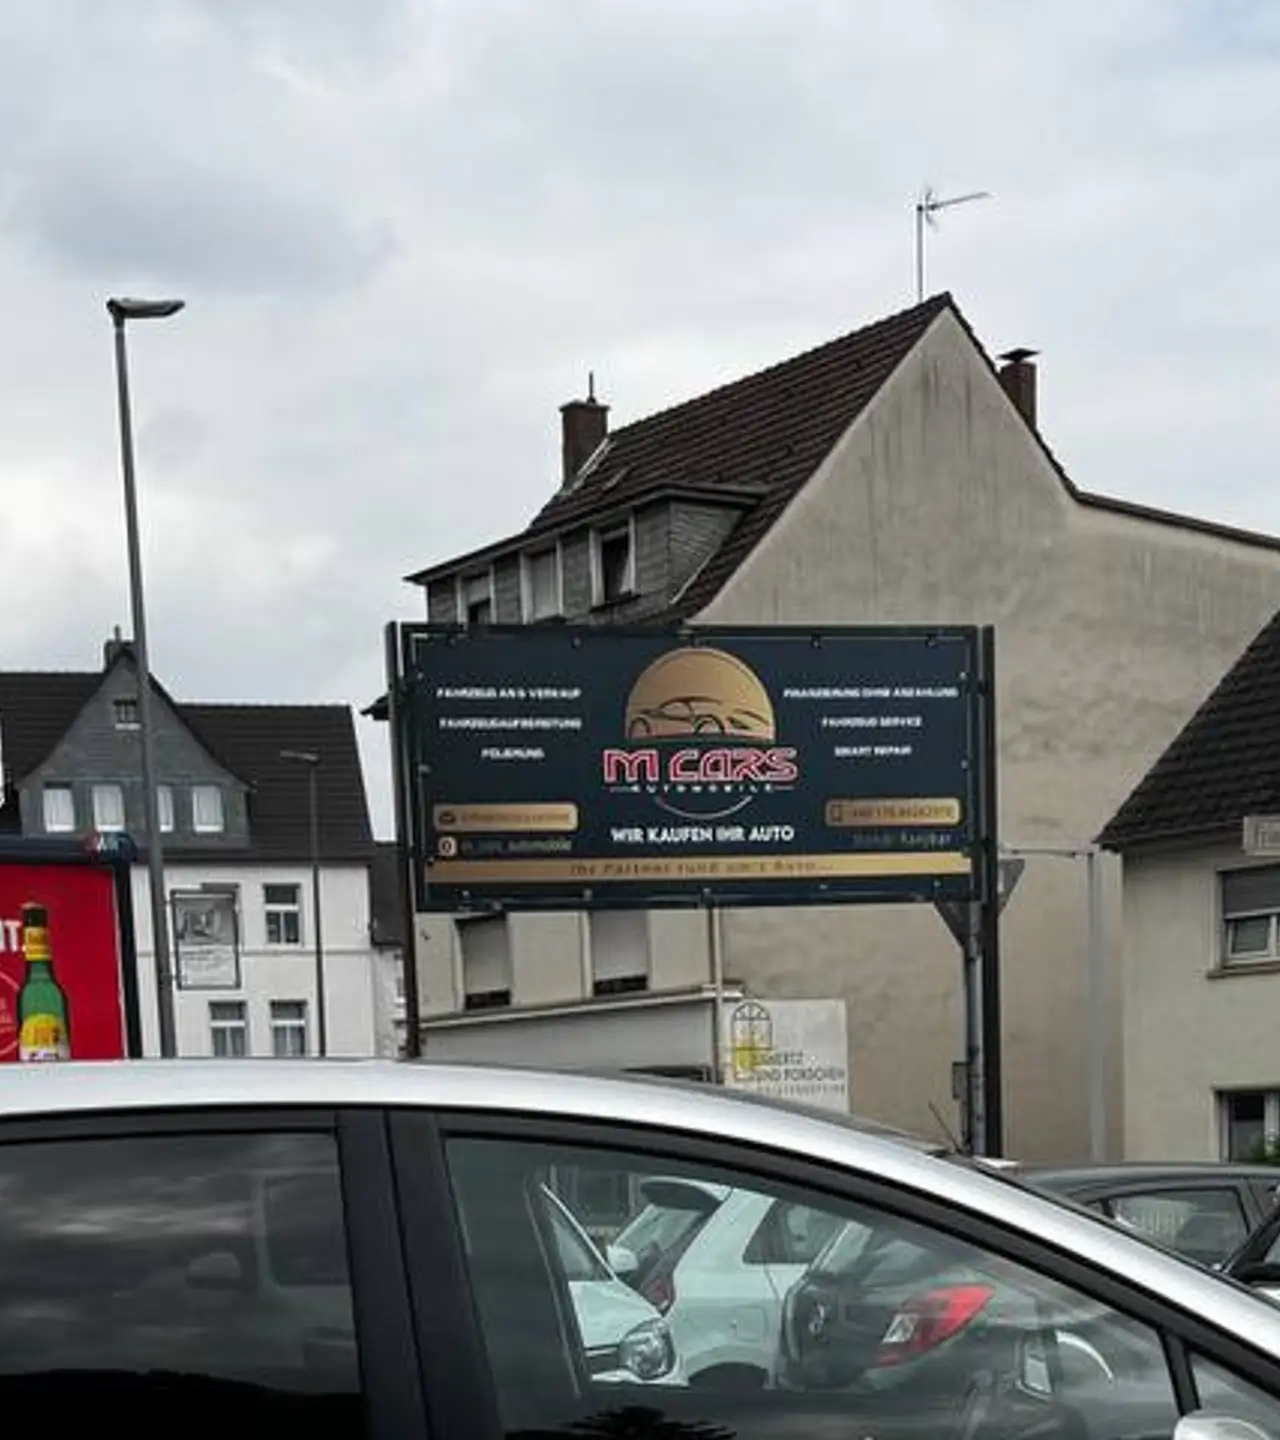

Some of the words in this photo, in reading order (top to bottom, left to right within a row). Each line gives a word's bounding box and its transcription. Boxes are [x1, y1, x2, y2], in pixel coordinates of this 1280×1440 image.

[610, 827, 645, 844] WIR
[646, 827, 714, 843] KAUFEN
[715, 827, 746, 842] IHR
[748, 825, 795, 842] AUTO
